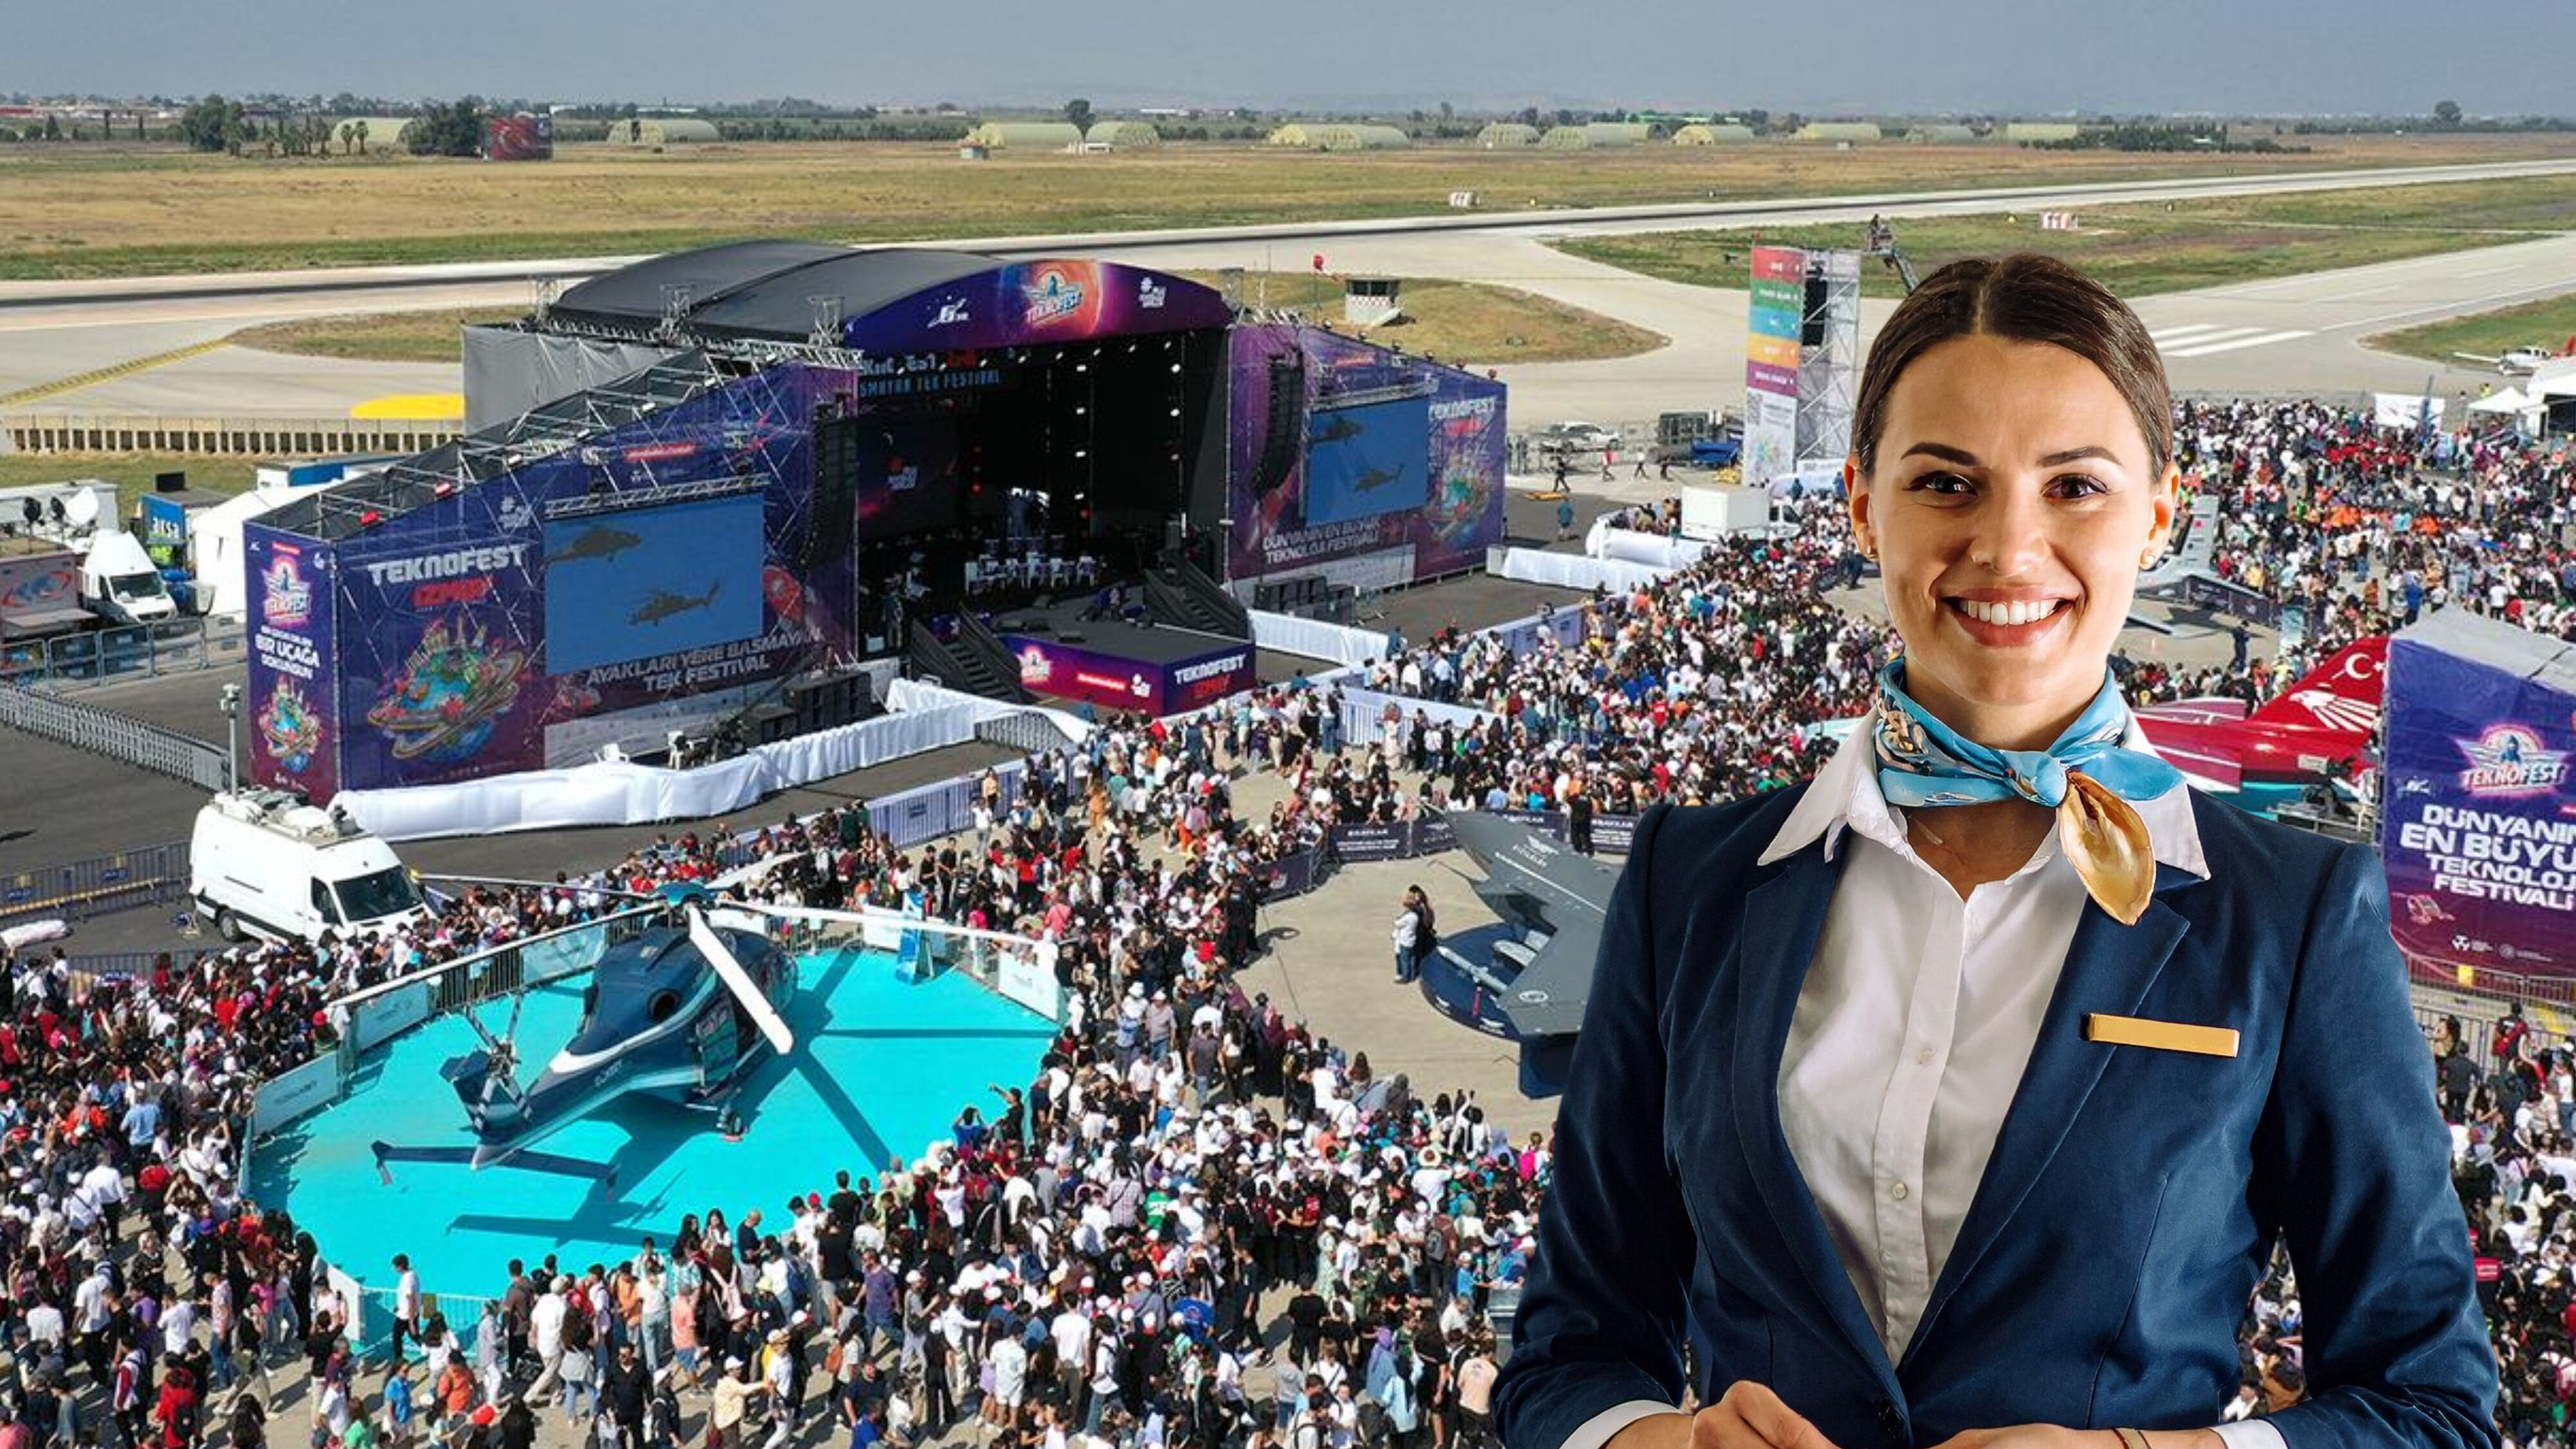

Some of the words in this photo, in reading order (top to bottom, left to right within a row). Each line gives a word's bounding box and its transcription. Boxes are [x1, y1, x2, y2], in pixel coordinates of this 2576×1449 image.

[368, 543, 529, 587] TEKNOFEST
[587, 655, 676, 685] AYAKLARI
[678, 645, 724, 669] YERE
[1175, 654, 1246, 685] TEKNOFEST
[643, 671, 681, 692] TEK
[2462, 763, 2566, 789] TEKNOFEST
[2400, 822, 2456, 853] EN
